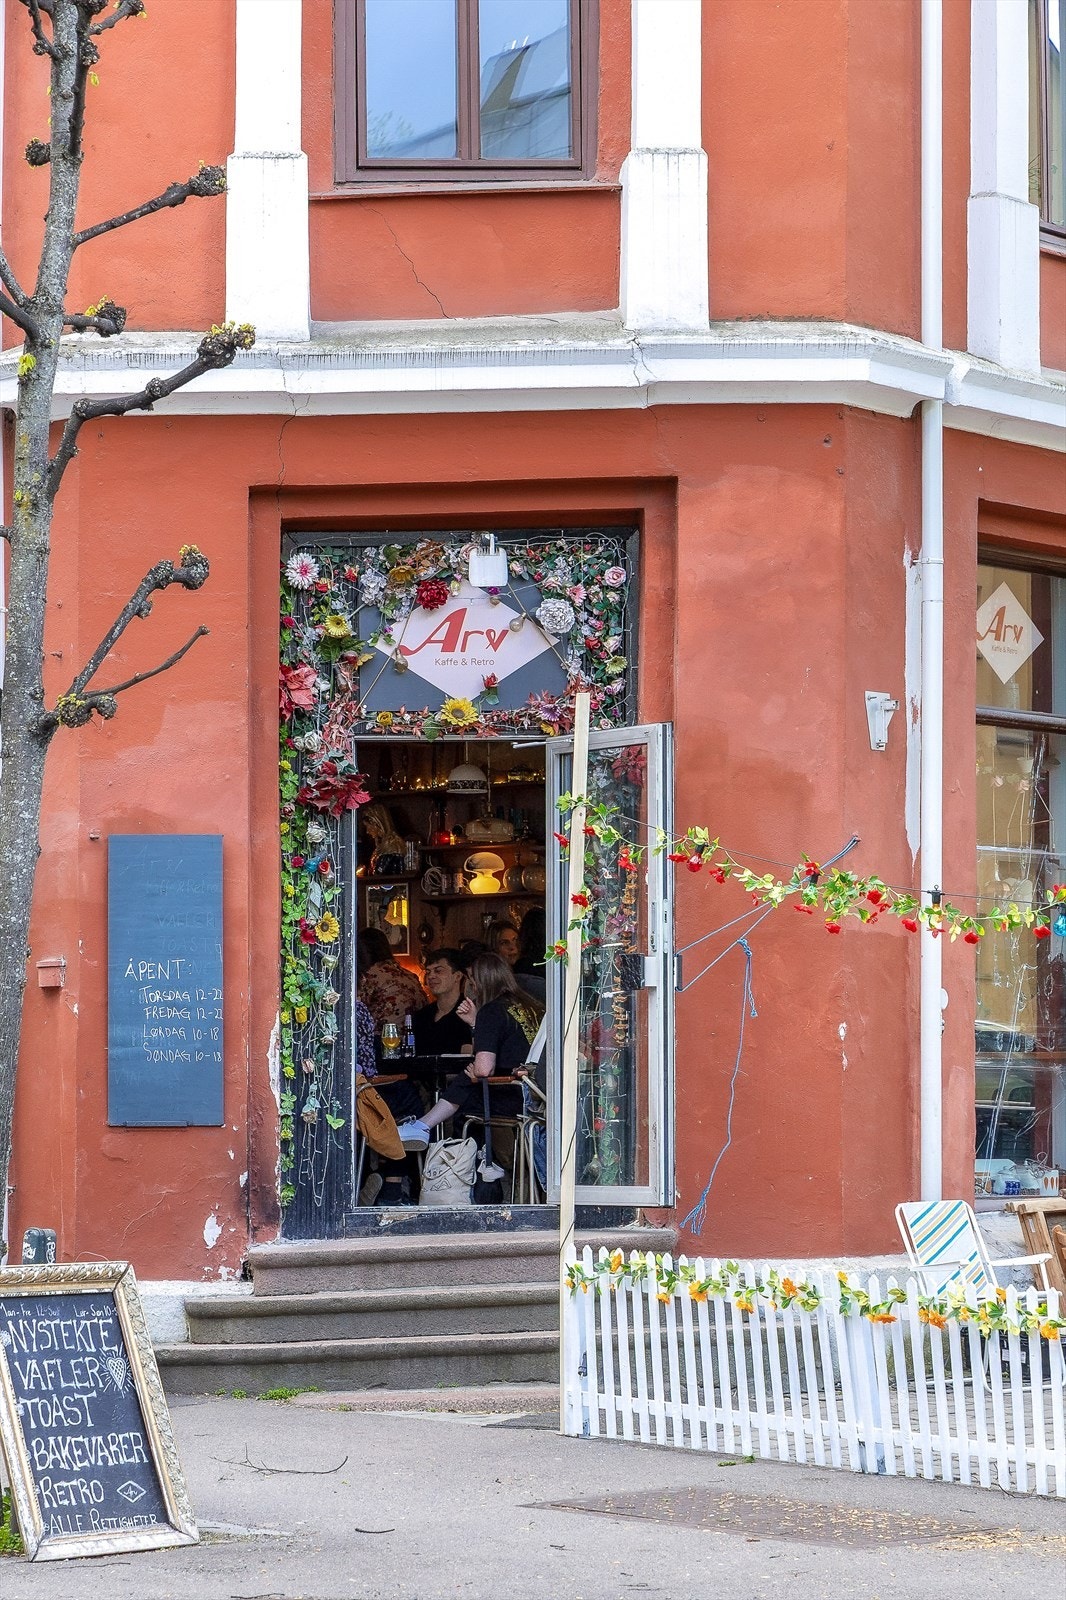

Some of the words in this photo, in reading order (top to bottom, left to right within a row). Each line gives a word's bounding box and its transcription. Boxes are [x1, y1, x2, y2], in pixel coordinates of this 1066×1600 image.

[400, 608, 509, 656] Arv
[976, 606, 1023, 644] Arv
[434, 658, 459, 666] Kaffe
[460, 658, 468, 666] &
[470, 658, 495, 666] Retro
[139, 985, 191, 1004] TORSDAG
[143, 1005, 191, 1021] FREDAG
[143, 1024, 186, 1041] LØRDAG
[192, 1027, 219, 1041] 10-18
[143, 1041, 191, 1063] SØNDAG
[7, 1317, 118, 1353] NYSTEKTE
[14, 1356, 104, 1391] VAFLER
[19, 1390, 97, 1429] TOAST
[31, 1432, 149, 1471] BAKEVARER
[39, 1476, 105, 1508] RETRO
[50, 1513, 84, 1535] ALLE
